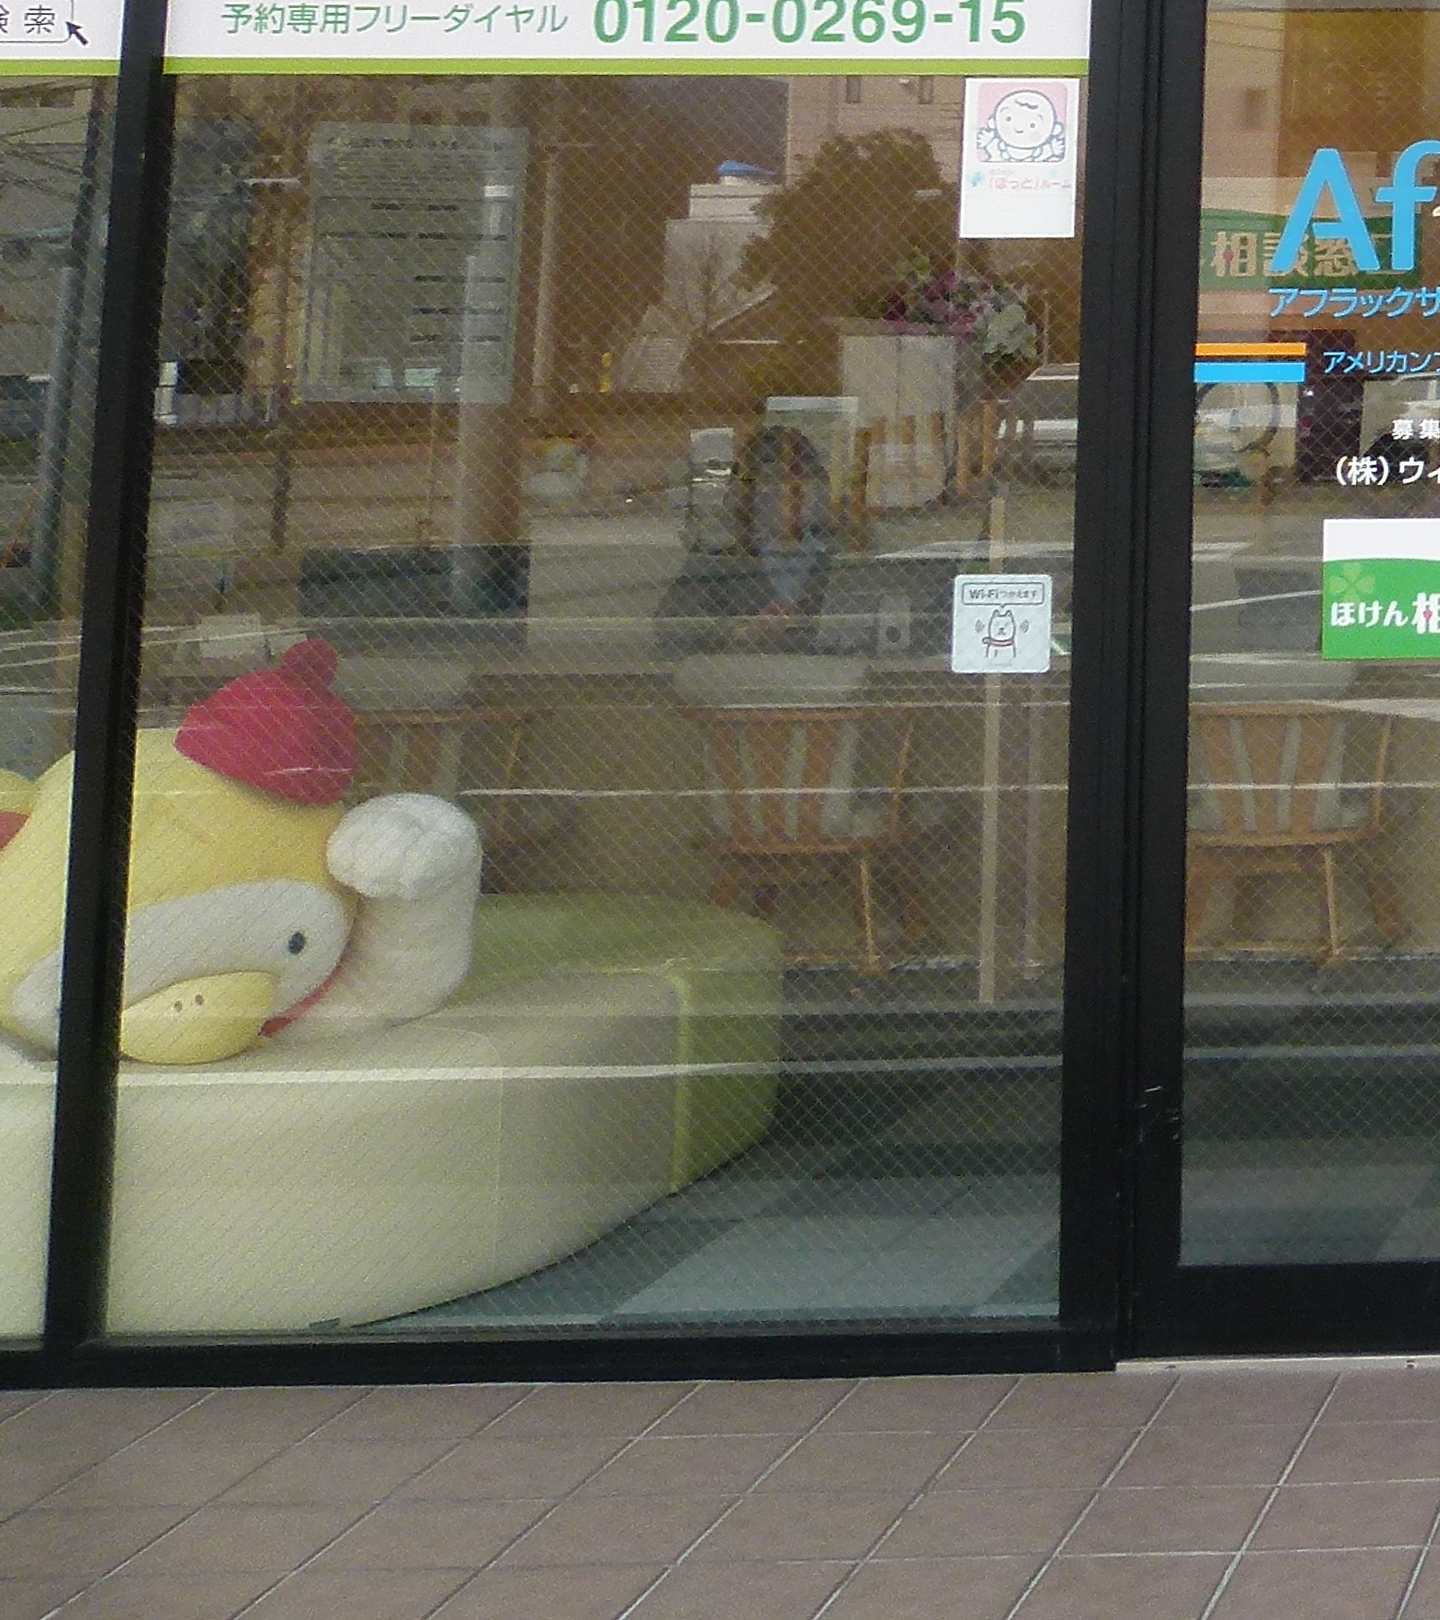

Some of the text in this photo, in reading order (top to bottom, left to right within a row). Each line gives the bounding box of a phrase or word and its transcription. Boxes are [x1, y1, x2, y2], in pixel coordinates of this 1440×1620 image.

[221, 1, 568, 37] 予約専用フリーダイヤル
